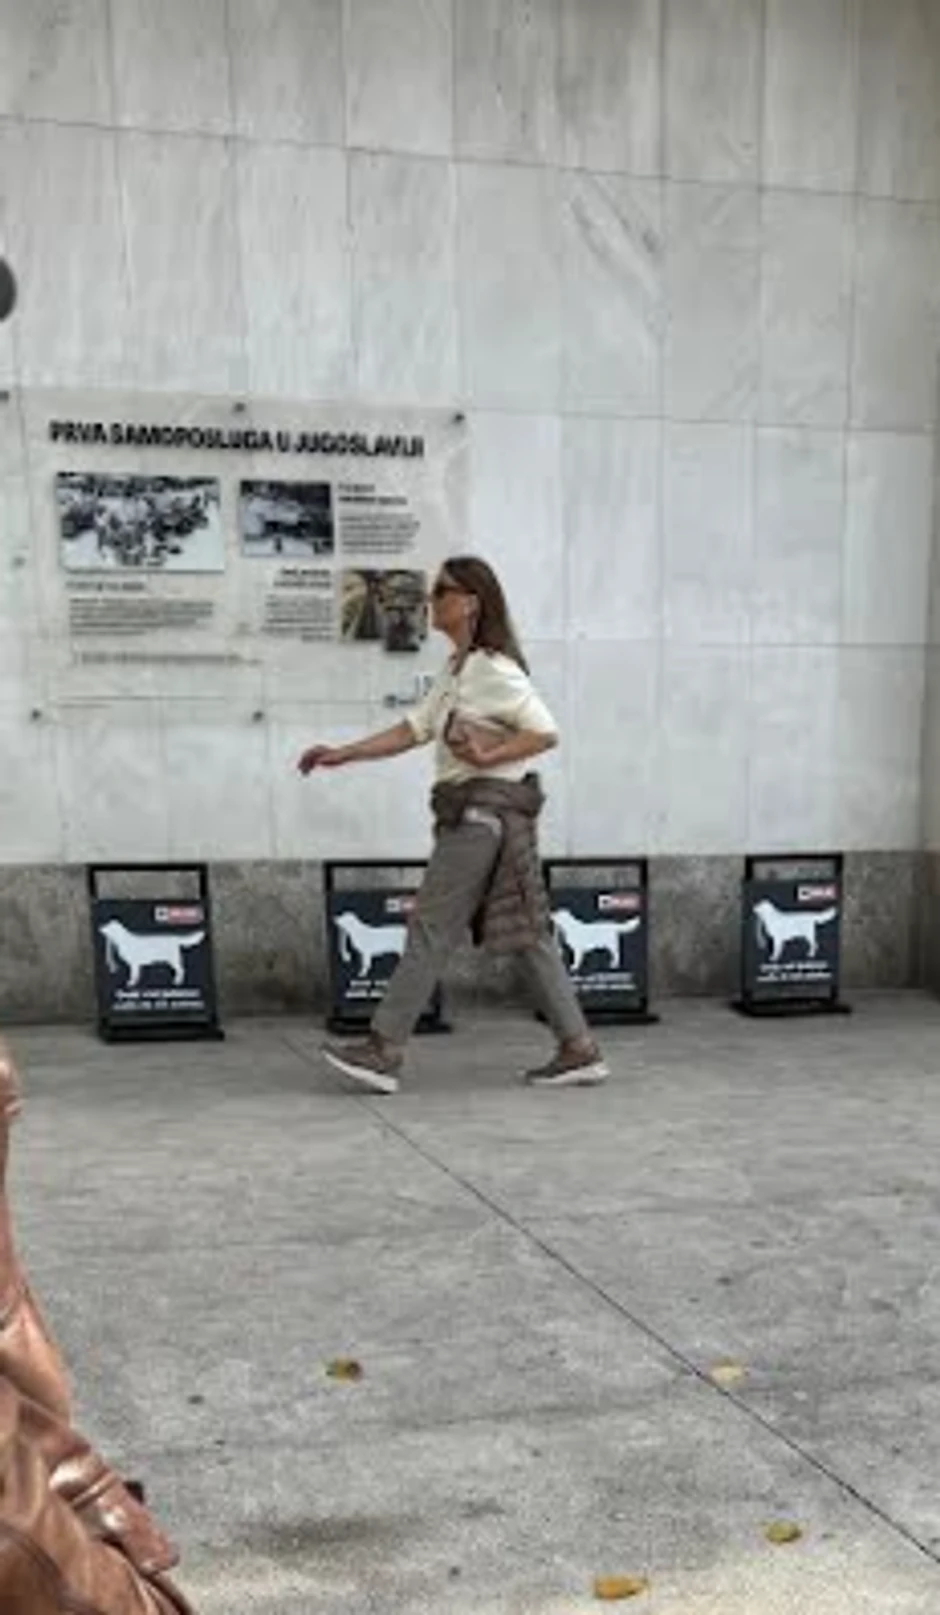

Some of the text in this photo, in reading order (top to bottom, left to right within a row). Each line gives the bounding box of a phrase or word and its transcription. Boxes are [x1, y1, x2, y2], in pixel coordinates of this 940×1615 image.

[50, 420, 107, 444] PRVA
[110, 422, 273, 450] SAMOPOSLUGA
[277, 430, 290, 452] U
